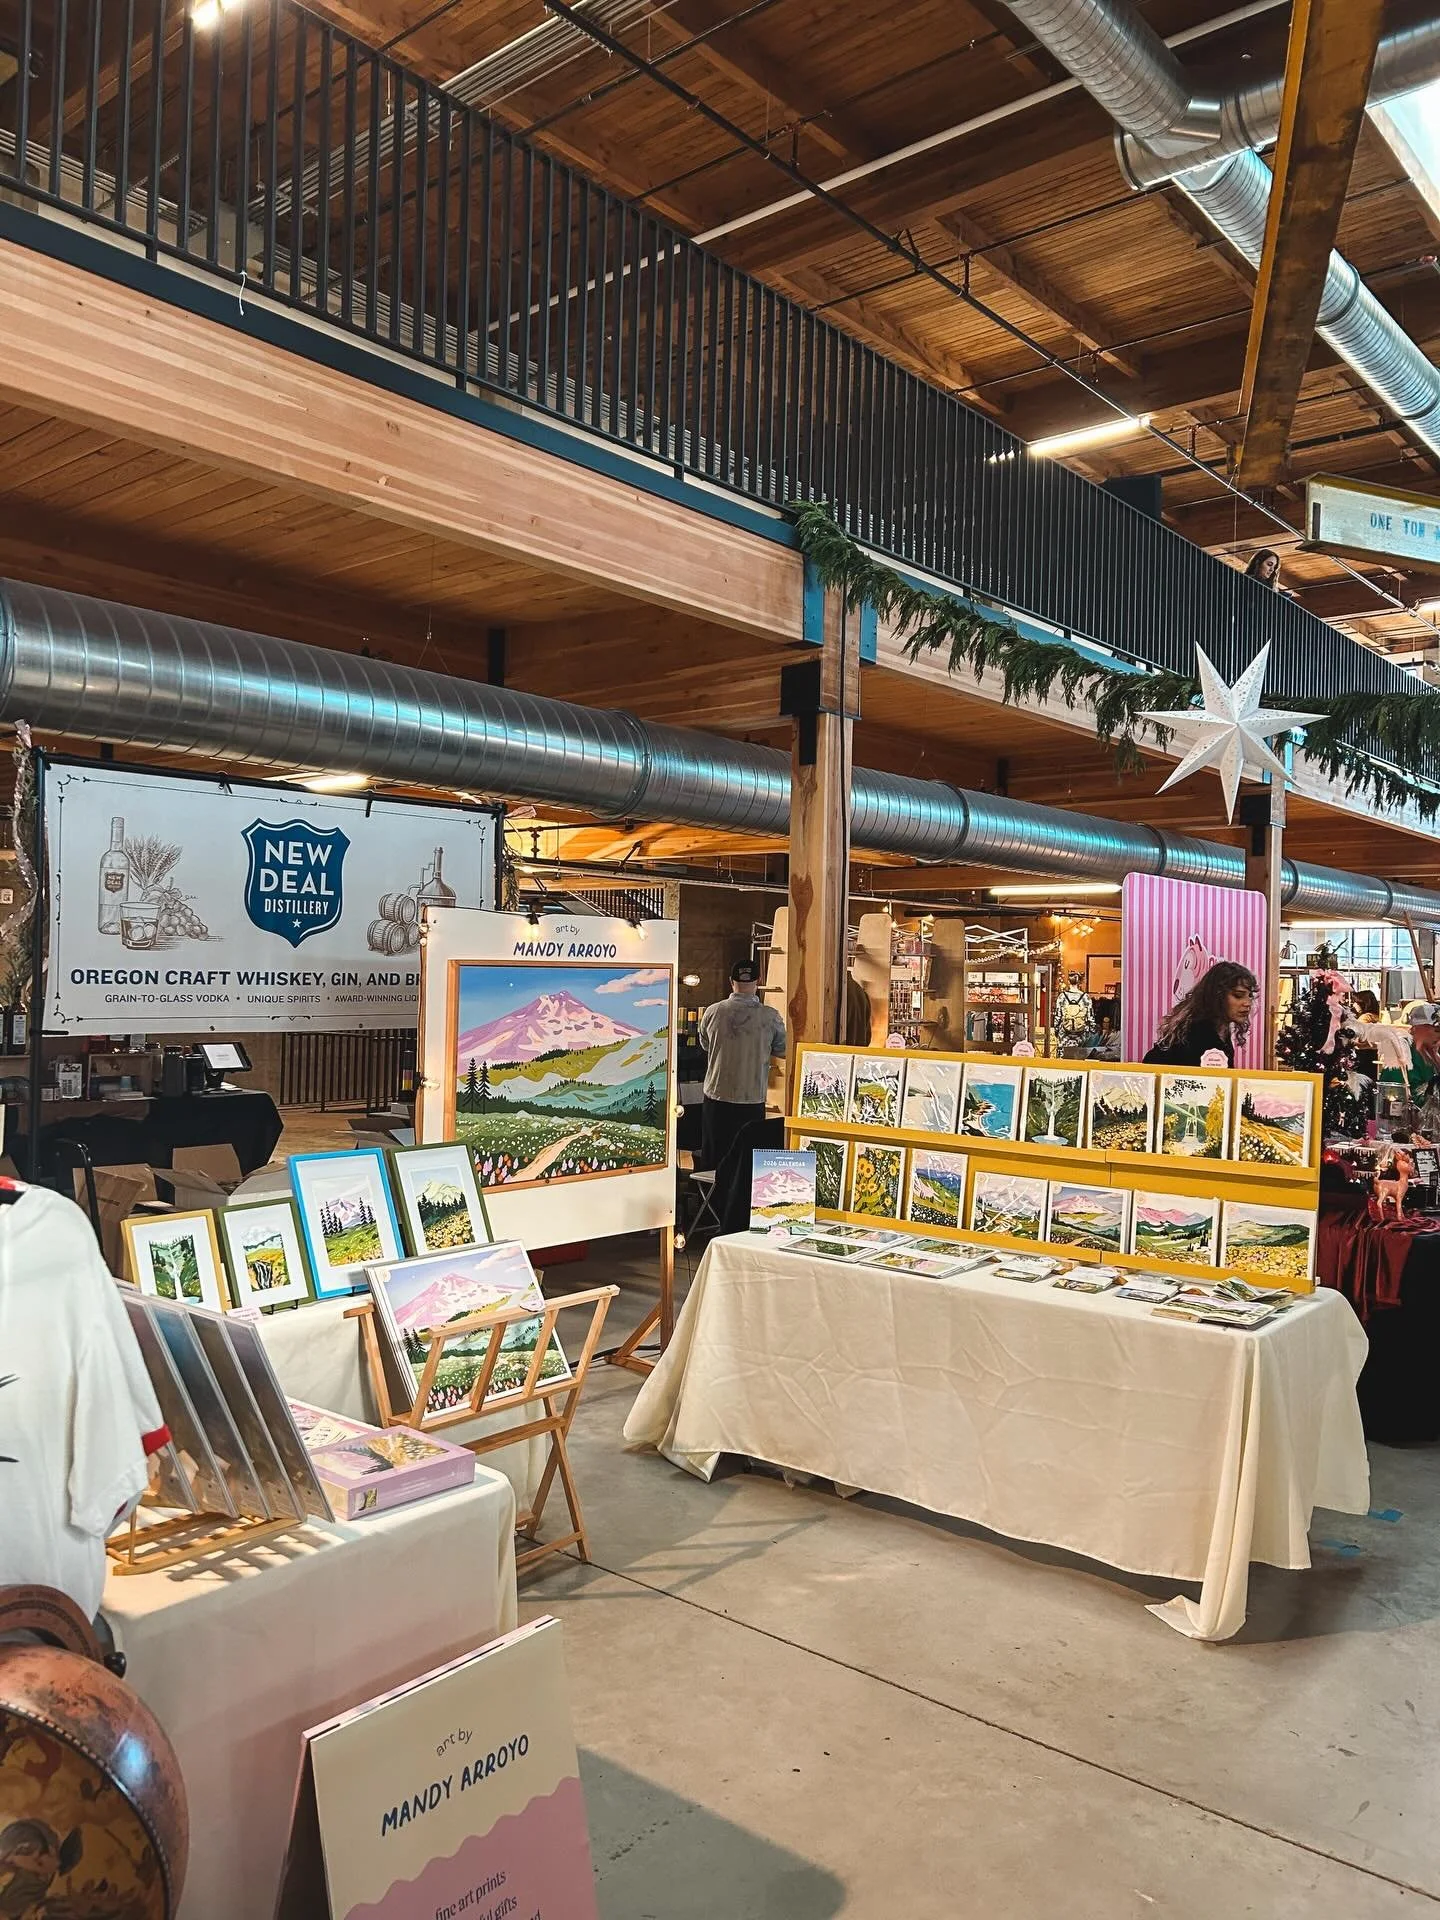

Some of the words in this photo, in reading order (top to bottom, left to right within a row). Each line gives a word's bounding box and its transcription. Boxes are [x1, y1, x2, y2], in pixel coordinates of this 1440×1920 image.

[1370, 512, 1392, 530] ONE
[264, 839, 333, 867] NEW
[260, 868, 334, 896] DEAL
[264, 898, 329, 915] DISTILLERY
[555, 925, 569, 933] art
[570, 925, 580, 935] by
[513, 942, 565, 957] MANDY
[568, 944, 617, 958] ARROYO
[70, 969, 159, 985] OREGON
[165, 970, 231, 985] CRAFT
[236, 971, 326, 988] WHISKEY,
[331, 972, 362, 988] GIN,
[367, 973, 400, 985] AND
[105, 994, 193, 1003] GRAIN-TO-GLASS
[196, 994, 230, 1003] VODKA
[247, 995, 284, 1003] UNIQUE
[287, 995, 321, 1003] SPIRITS
[436, 1733, 455, 1756] art
[458, 1728, 473, 1744] by
[381, 1775, 452, 1836] MANDY
[460, 1735, 529, 1791] ARROYO
[458, 1890, 474, 1911] art
[475, 1871, 507, 1904] prints
[494, 1896, 518, 1920] gifts
